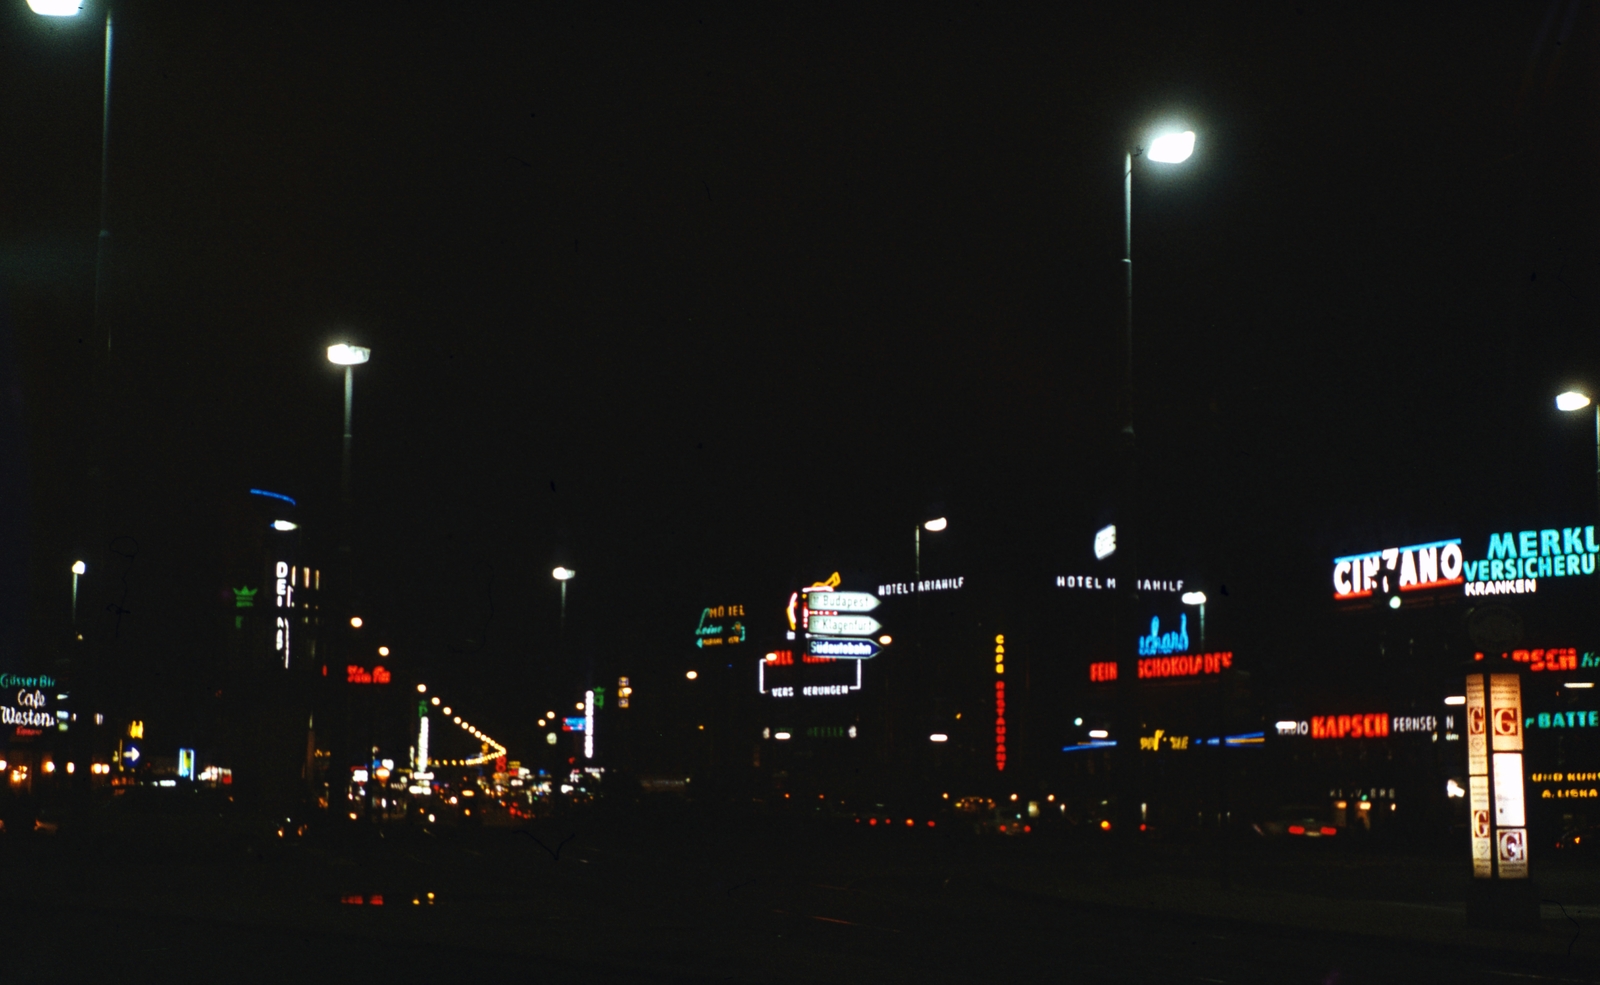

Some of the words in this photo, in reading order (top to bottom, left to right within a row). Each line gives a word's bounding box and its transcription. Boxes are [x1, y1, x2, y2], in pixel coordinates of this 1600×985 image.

[1464, 553, 1600, 582] VERSICHERU
[878, 583, 909, 596] HOTEL
[1056, 575, 1102, 589] HOTEL
[1106, 577, 1184, 592] MIAHILF
[1464, 578, 1537, 597] KRANKEN
[823, 595, 869, 608] Budapest
[823, 619, 872, 633] Klagenfurt
[811, 641, 872, 654] Südautobahn
[0, 673, 38, 688] Gösser
[995, 680, 1006, 772] RESTAURANT
[1311, 712, 1389, 739] KAPSCH
[1495, 708, 1517, 735] G
[1537, 710, 1600, 728] BATTE
[1532, 772, 1563, 782] UND
